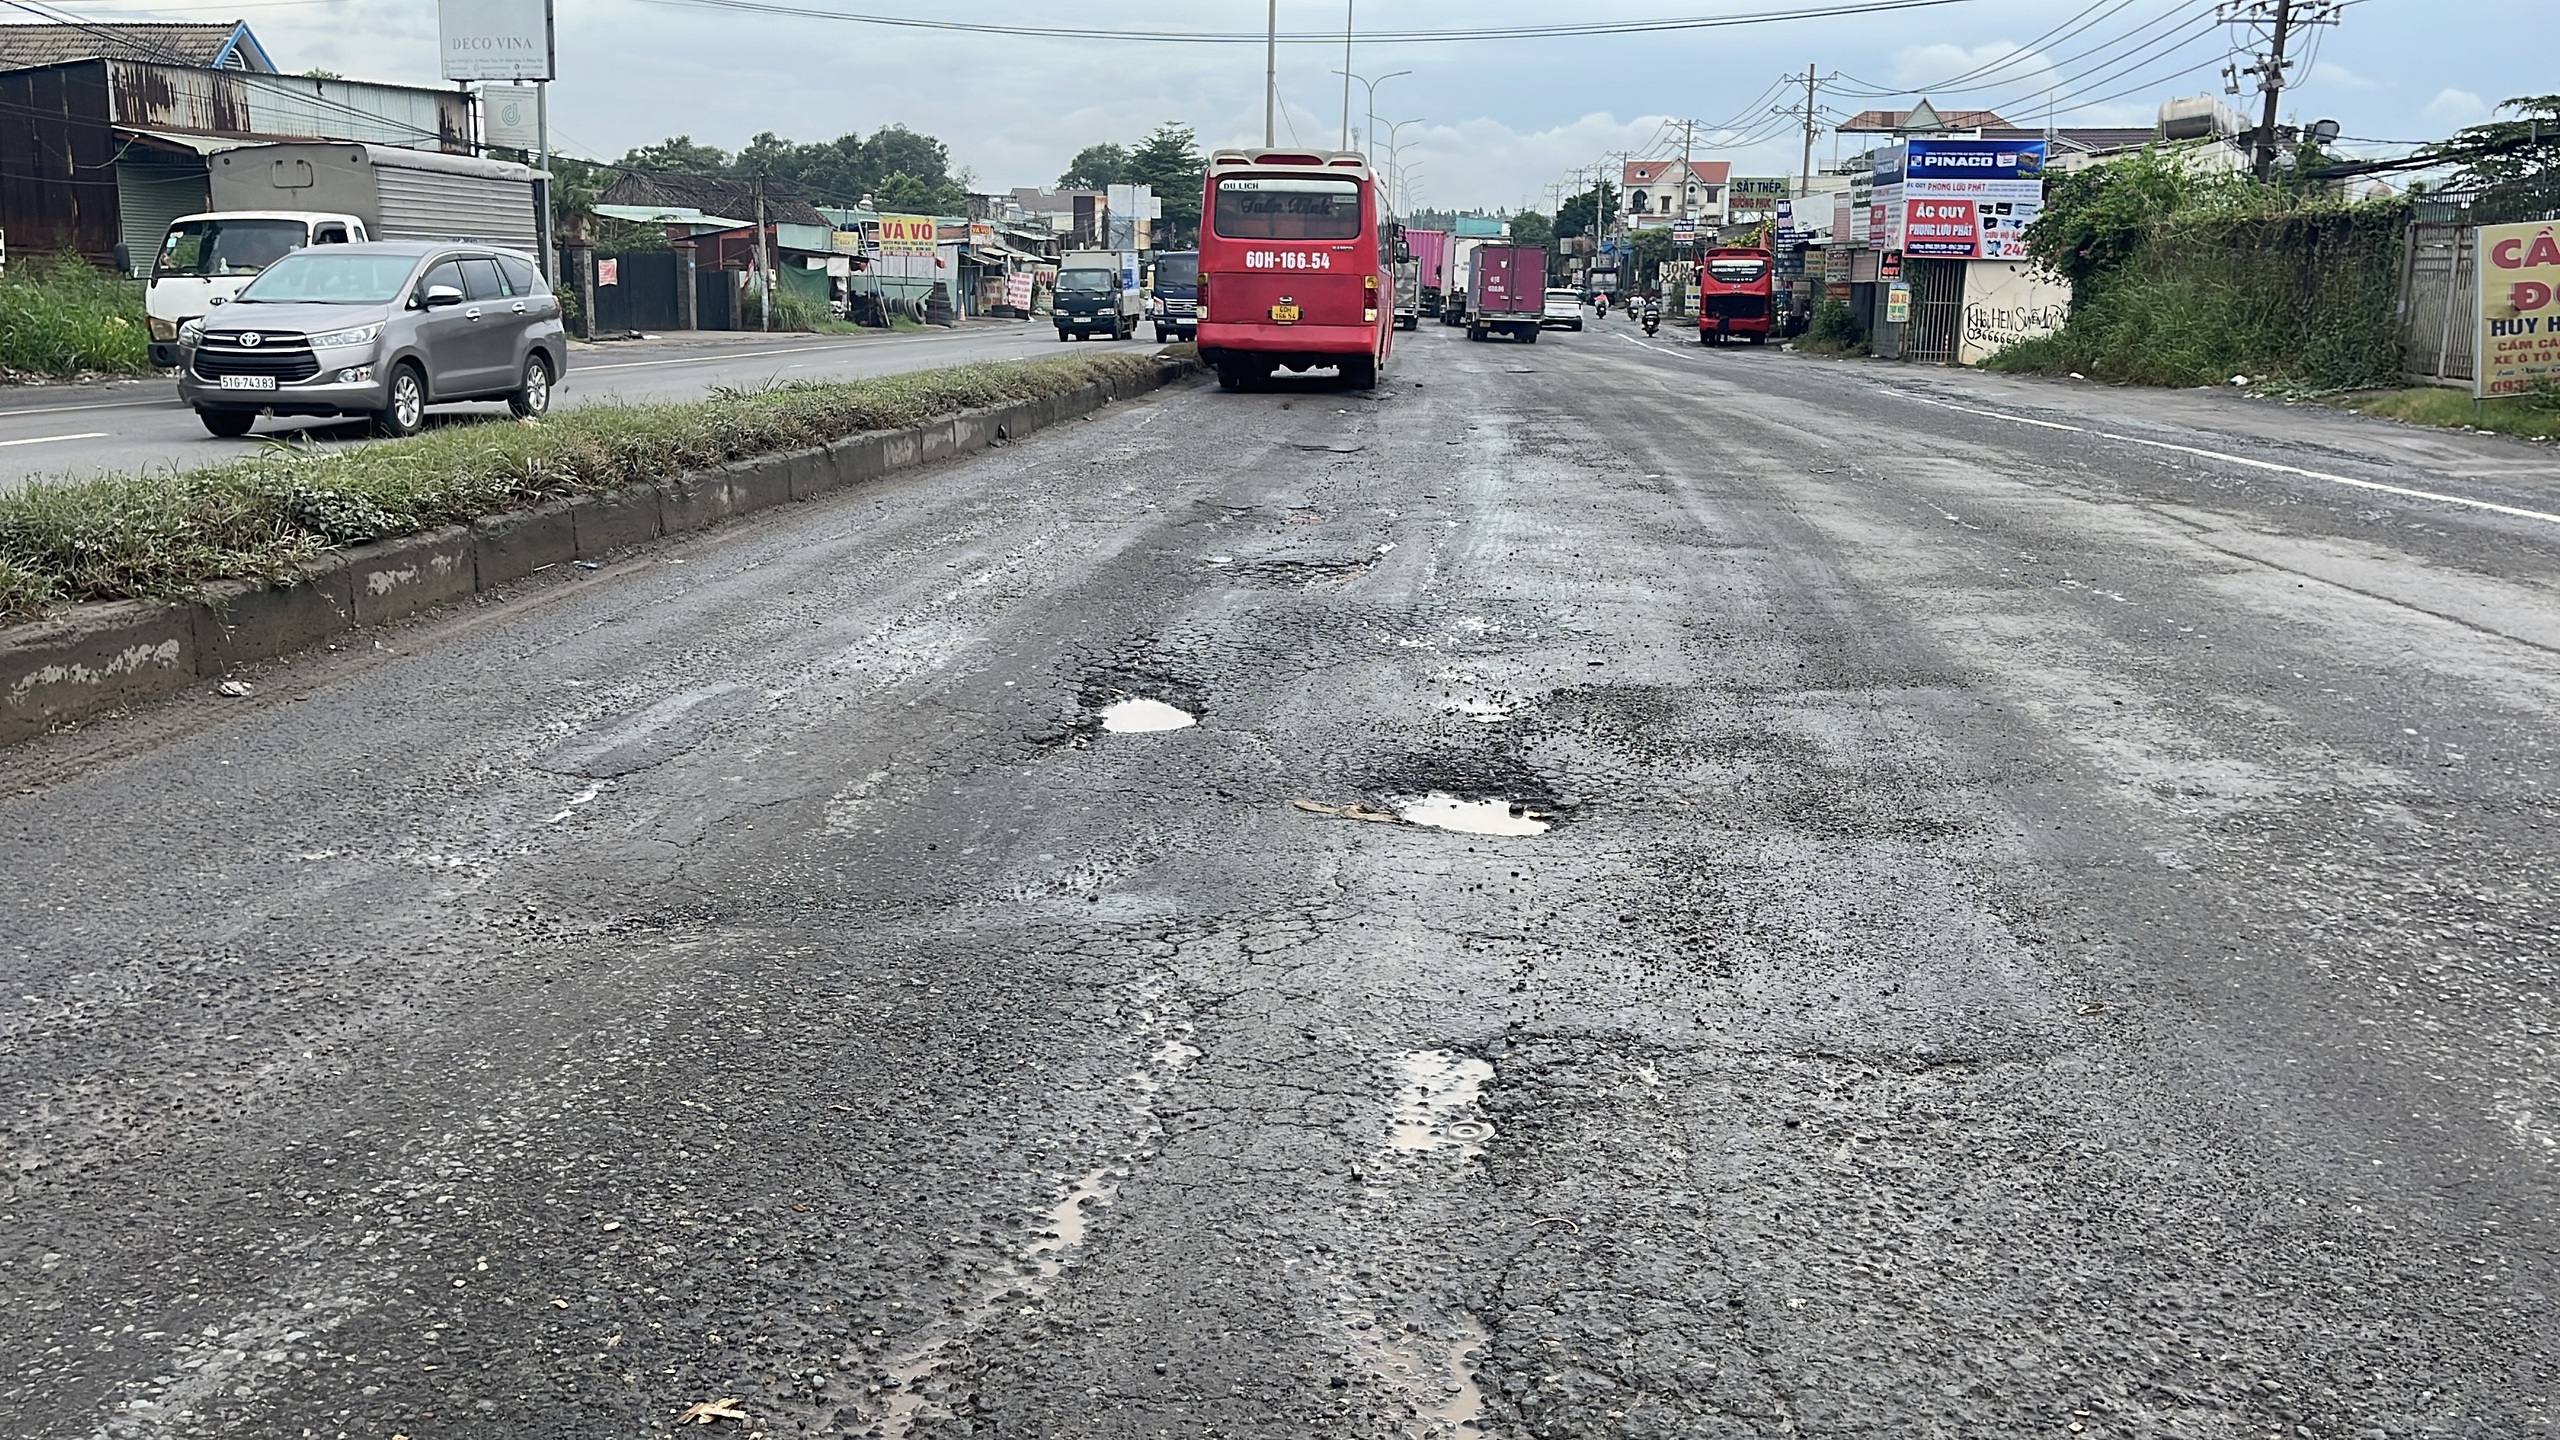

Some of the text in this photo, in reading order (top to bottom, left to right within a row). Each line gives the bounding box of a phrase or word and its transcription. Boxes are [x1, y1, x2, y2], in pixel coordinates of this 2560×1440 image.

[453, 38, 532, 49] DECO VINA
[1925, 156, 1993, 166] PINACO
[1223, 182, 1235, 190] DU
[1757, 179, 1781, 193] THÉP
[1928, 183, 1951, 191] PHONG
[1939, 206, 1966, 219] QUY
[883, 218, 933, 240] VÁ VỎ
[1909, 224, 1935, 236] PHONG
[1992, 308, 2013, 330] HEN
[2491, 317, 2539, 336] HUY
[2494, 355, 2513, 365] XE
